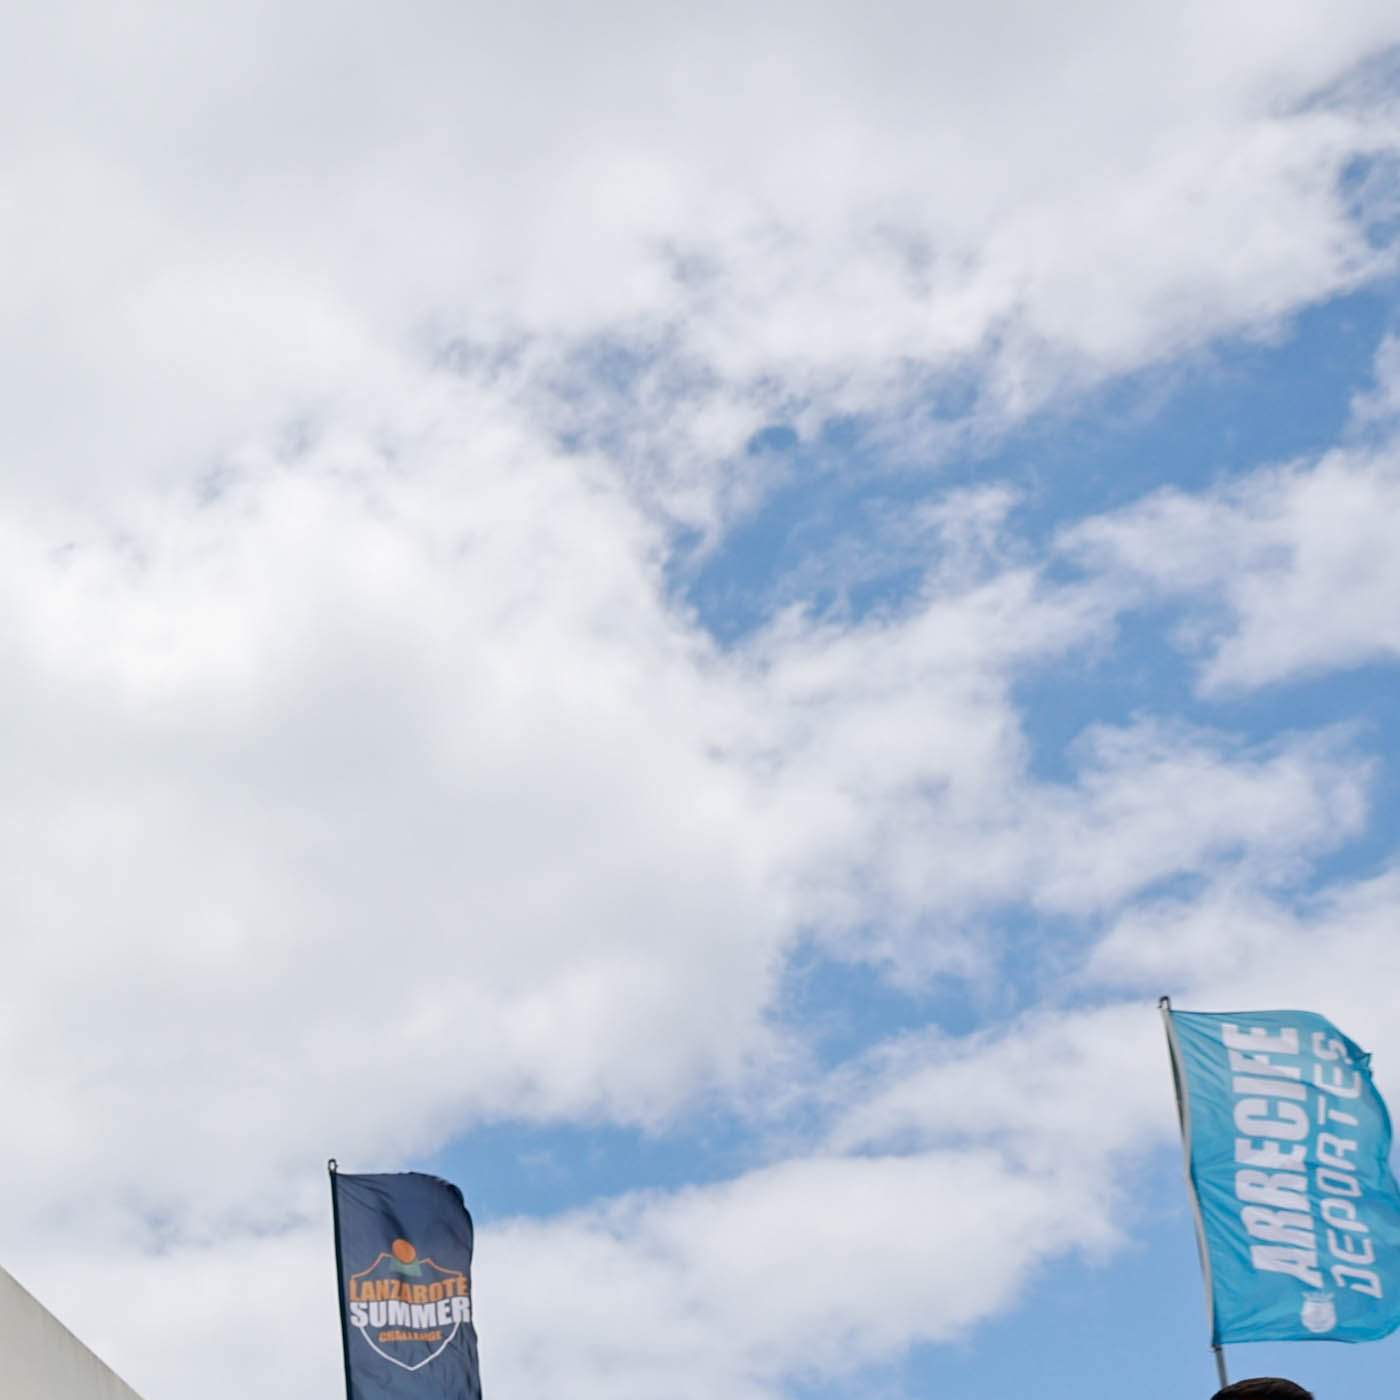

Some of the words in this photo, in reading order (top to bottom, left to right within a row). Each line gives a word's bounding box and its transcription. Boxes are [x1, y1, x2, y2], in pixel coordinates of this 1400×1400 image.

[1221, 1022, 1324, 1288] ARRECIFE
[1312, 1032, 1384, 1299] DEPORTES
[349, 1274, 470, 1304] LANZAROTE
[349, 1296, 472, 1329] SUMMER
